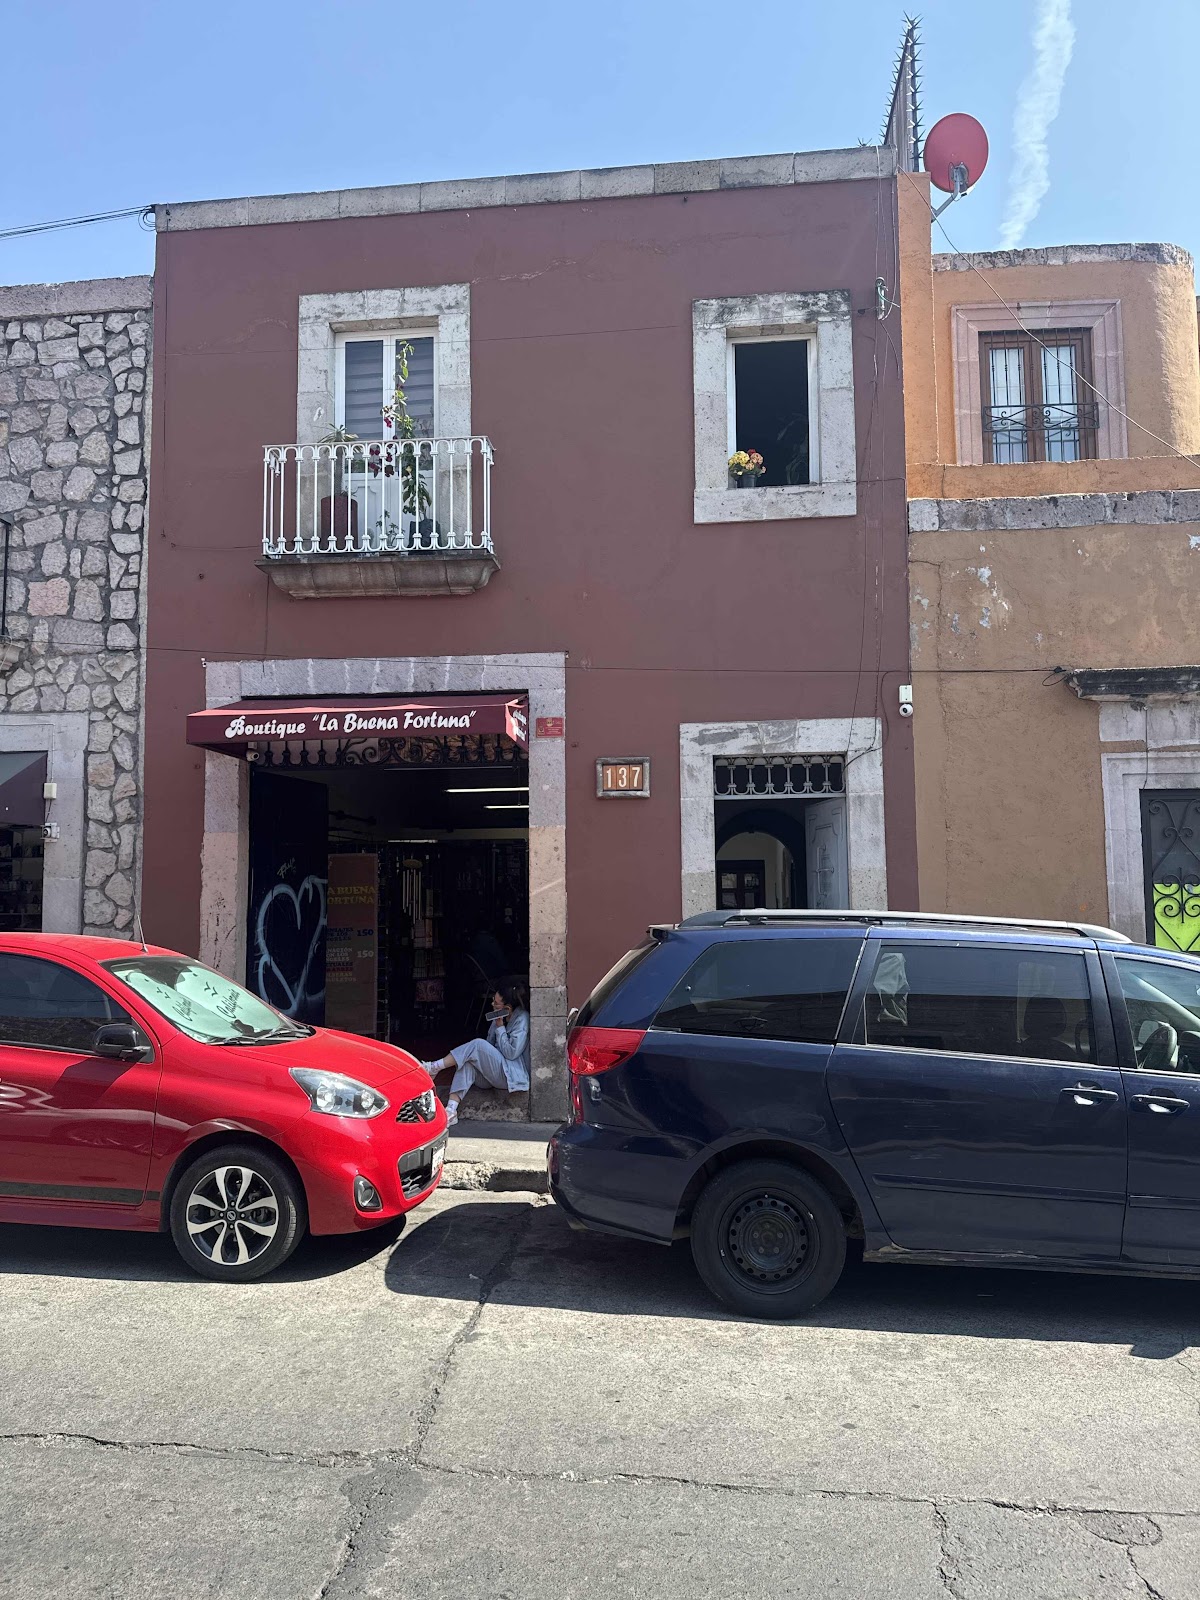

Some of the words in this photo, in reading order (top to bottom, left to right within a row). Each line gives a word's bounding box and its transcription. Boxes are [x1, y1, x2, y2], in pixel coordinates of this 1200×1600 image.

[224, 715, 307, 739] Boutique
[343, 712, 399, 733] Buena
[606, 766, 641, 788] 137
[327, 887, 336, 895] A
[337, 886, 376, 894] BUENA
[327, 896, 374, 904] ORTUNA
[357, 950, 374, 958] 150
